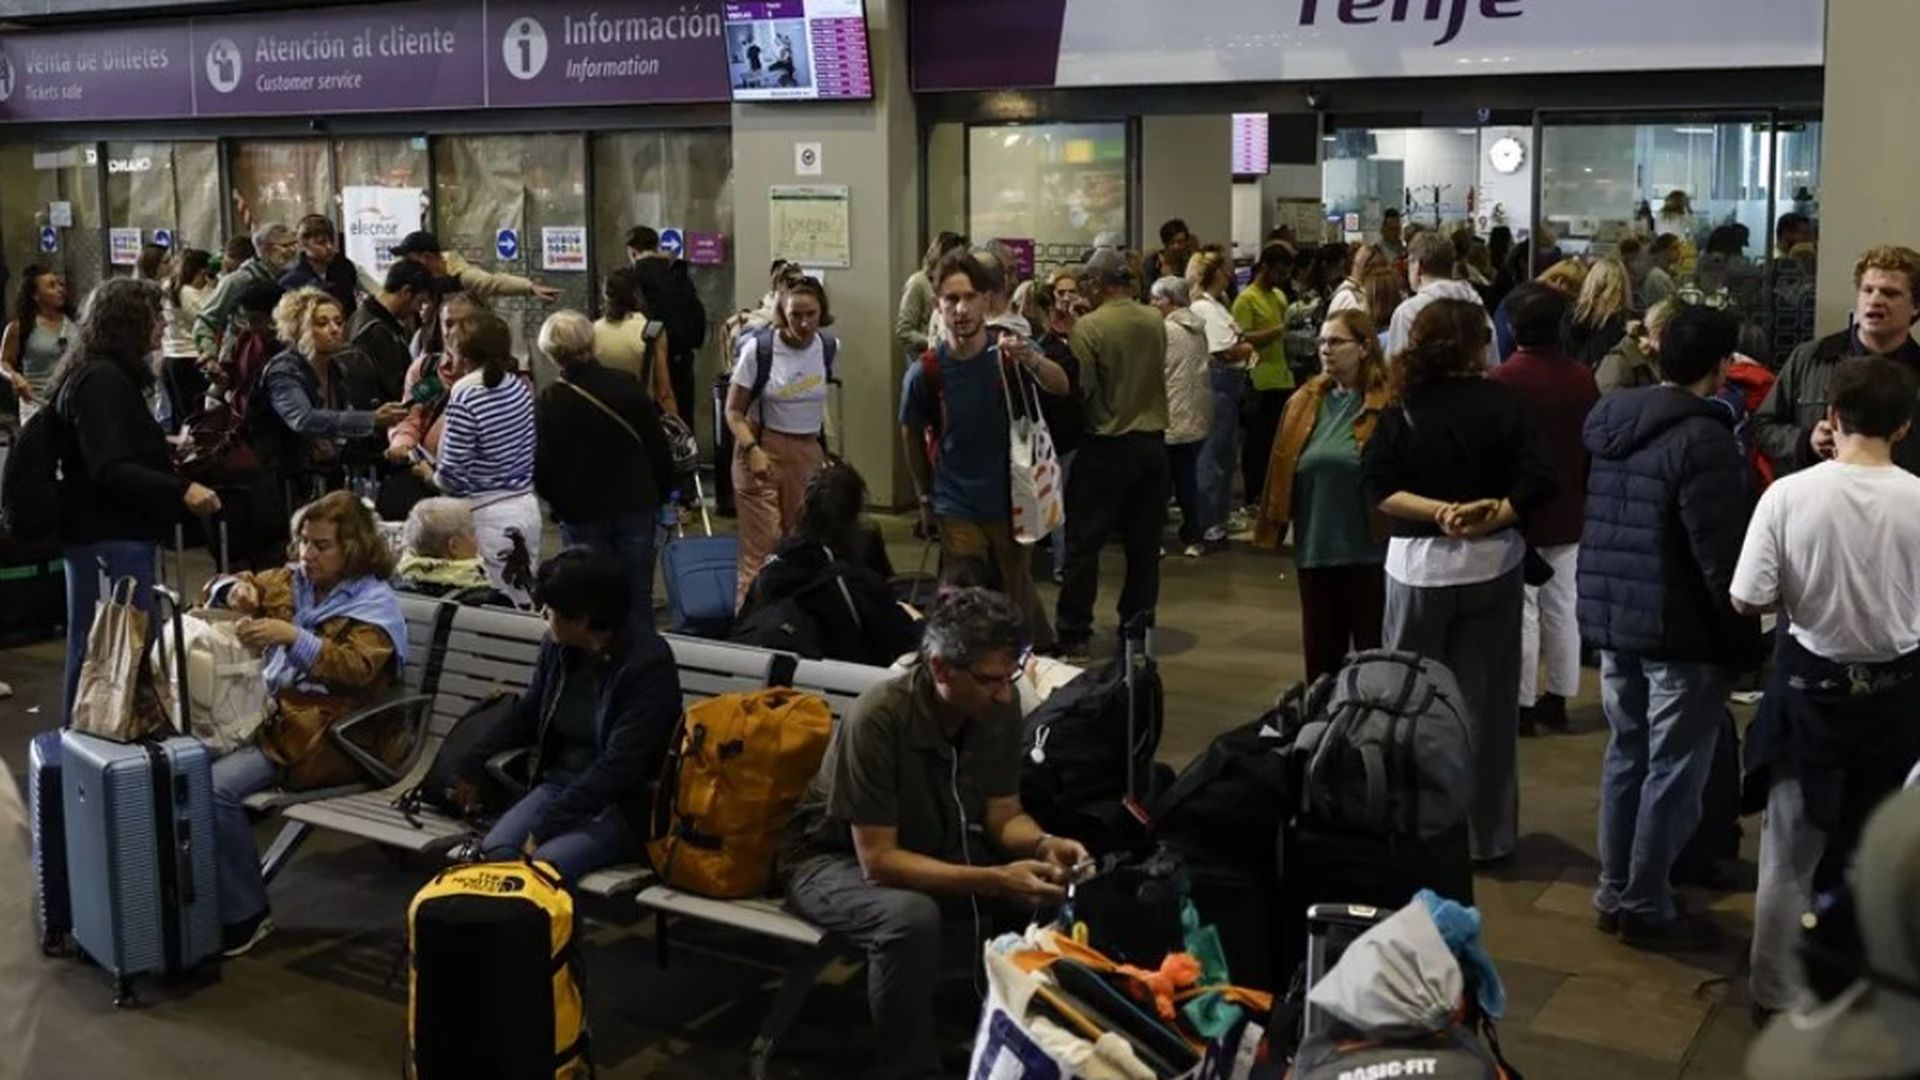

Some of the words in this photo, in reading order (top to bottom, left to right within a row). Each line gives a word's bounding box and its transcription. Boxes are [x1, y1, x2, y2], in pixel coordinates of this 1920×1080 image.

[564, 5, 721, 45] Información
[255, 31, 345, 62] Atención
[353, 27, 372, 58] al
[379, 24, 454, 57] cliente
[26, 50, 70, 74] Venta
[77, 47, 97, 71] de
[103, 45, 169, 71] billetes
[566, 55, 659, 82] Information
[256, 74, 314, 92] Customer
[317, 70, 363, 89] service
[1478, 108, 1489, 122] 9
[1338, 1058, 1437, 1080] BASIC-FIT
